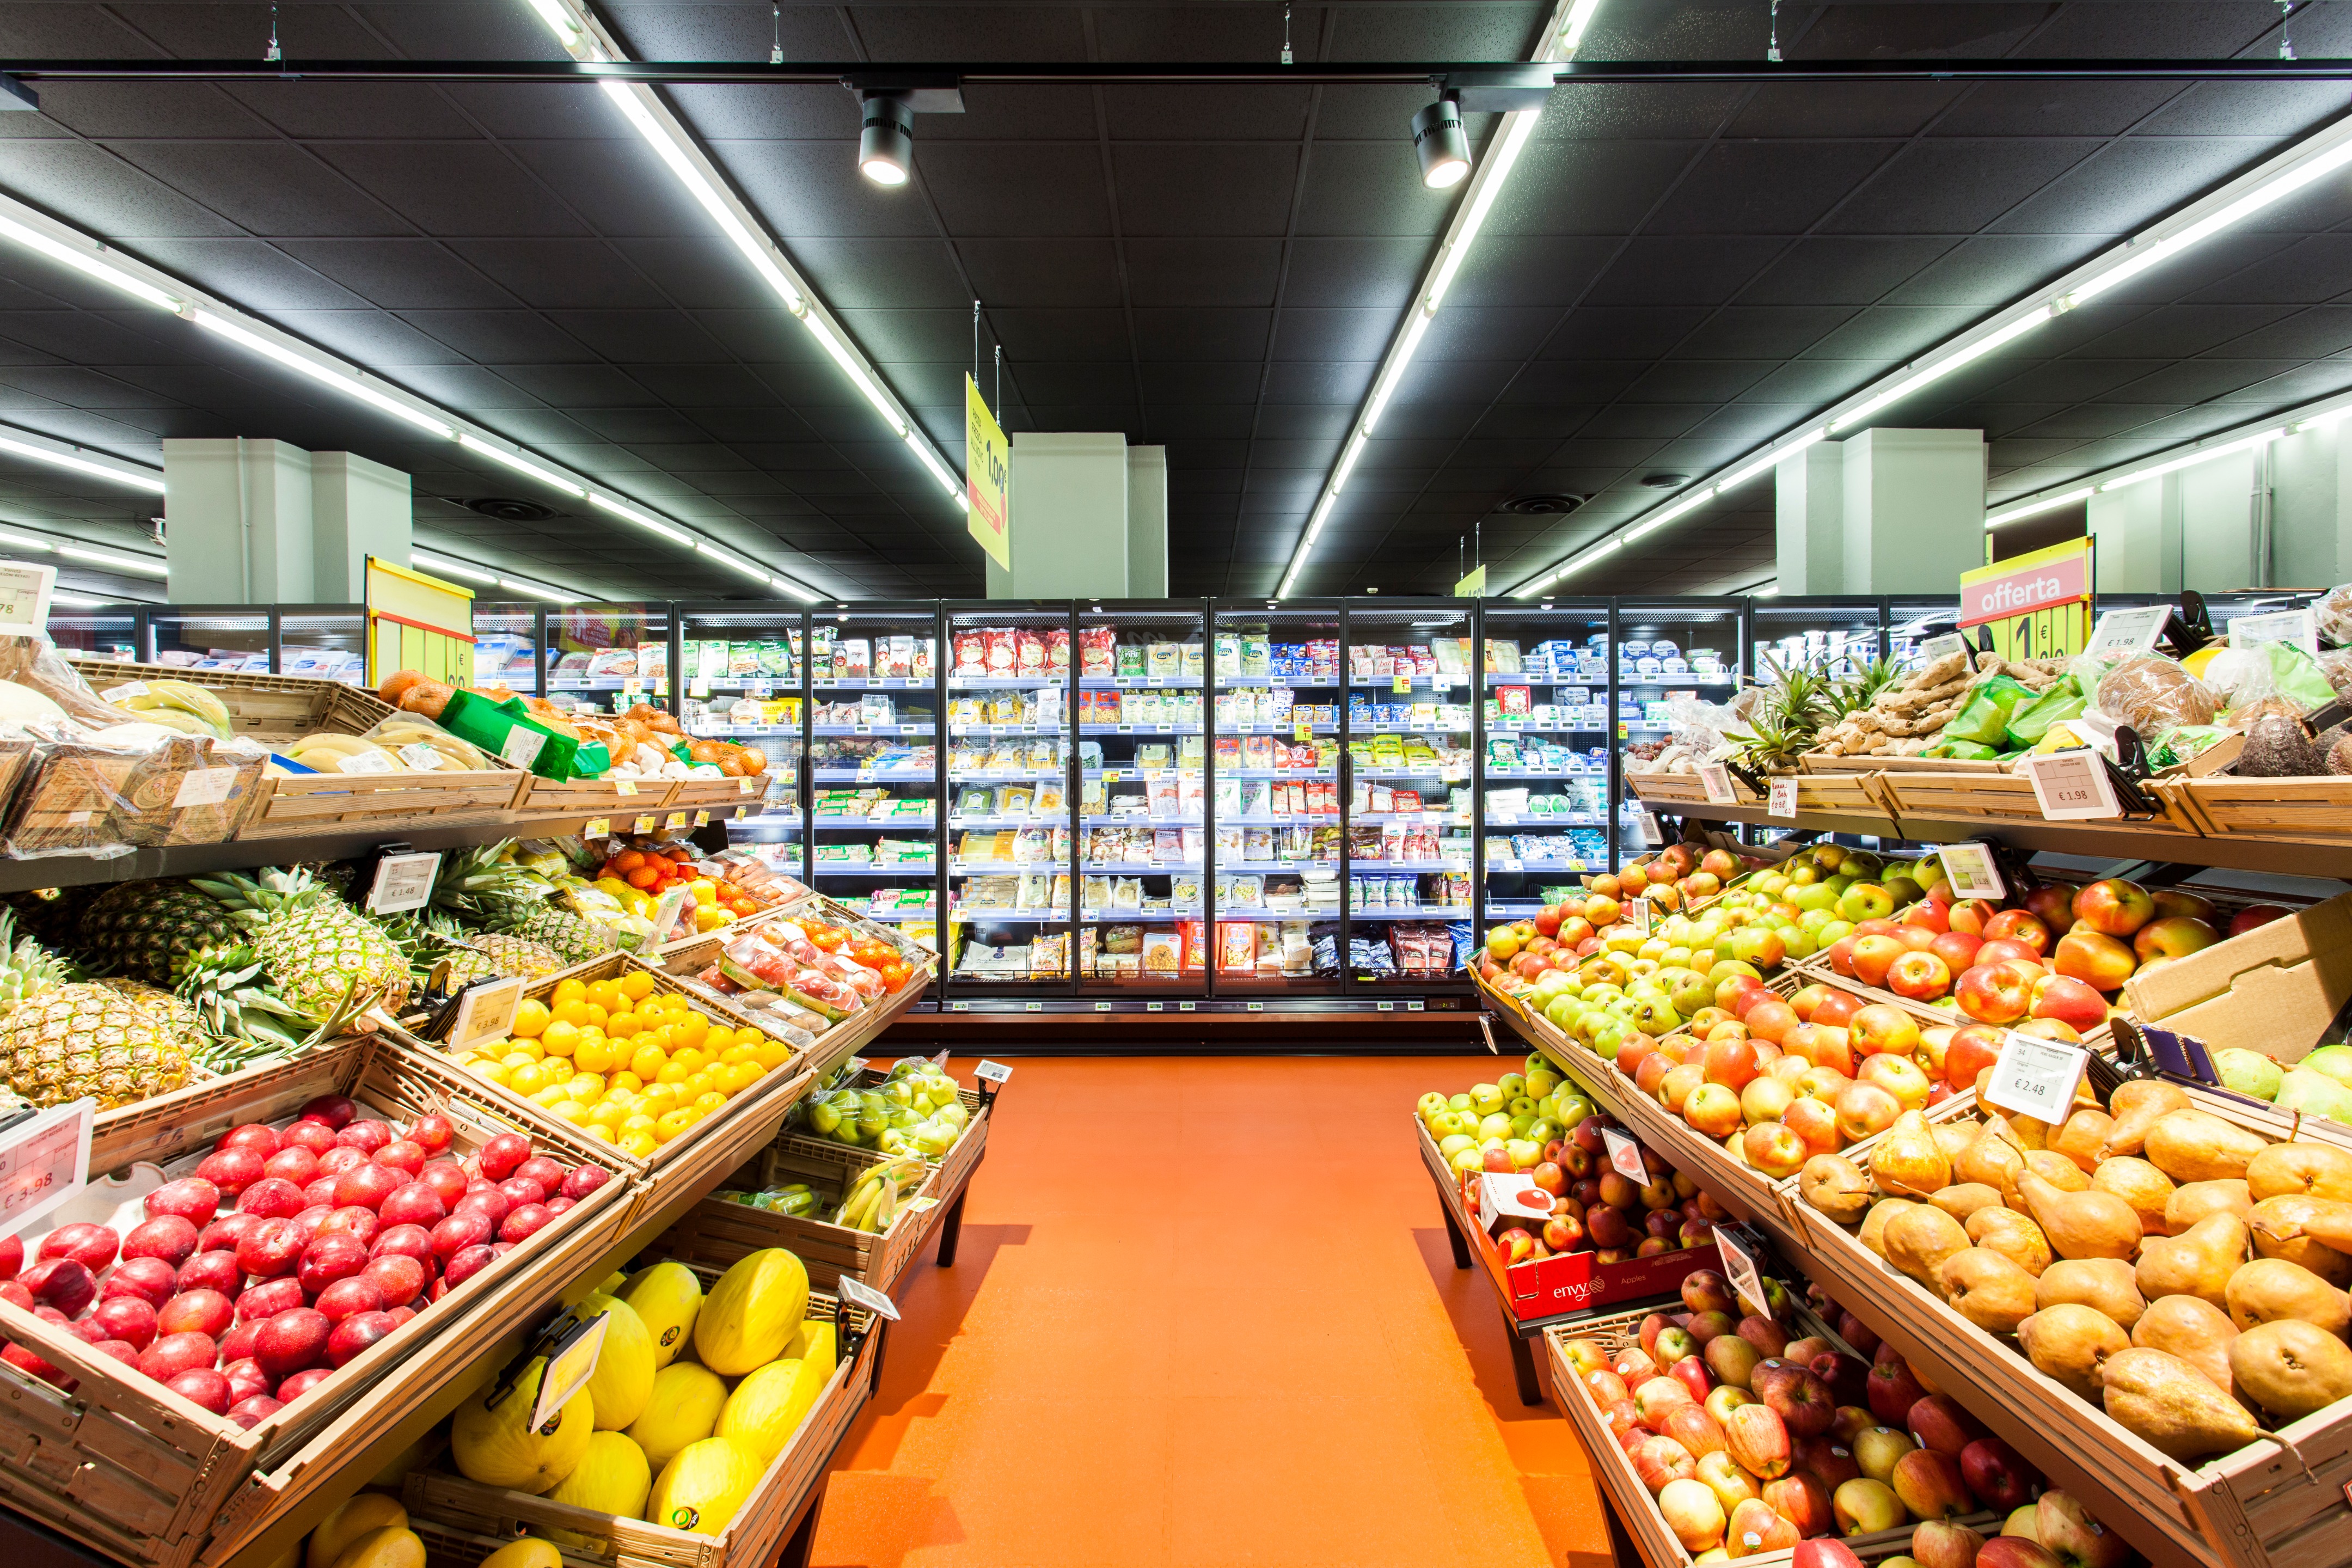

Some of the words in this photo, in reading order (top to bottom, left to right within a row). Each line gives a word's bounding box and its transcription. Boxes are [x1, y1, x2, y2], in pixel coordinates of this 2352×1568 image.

[972, 408, 982, 431] PASTA
[972, 422, 982, 445] FRESCA
[1981, 577, 2060, 612] offerta
[2041, 625, 2047, 639] €
[459, 653, 464, 665] €
[2059, 792, 2065, 801] €
[2067, 790, 2087, 800] 1.98
[398, 887, 415, 896] 1.48
[902, 891, 927, 901] Buitoni
[476, 1022, 482, 1031] €
[482, 1016, 500, 1029] 3.98
[2015, 1079, 2022, 1088] €
[2023, 1081, 2045, 1095] 2.48
[54, 1140, 78, 1153] Categoria
[5, 1194, 13, 1209] €
[19, 1172, 53, 1202] 3.98
[1621, 1275, 1646, 1285] Apples
[1553, 1282, 1591, 1302] envy
